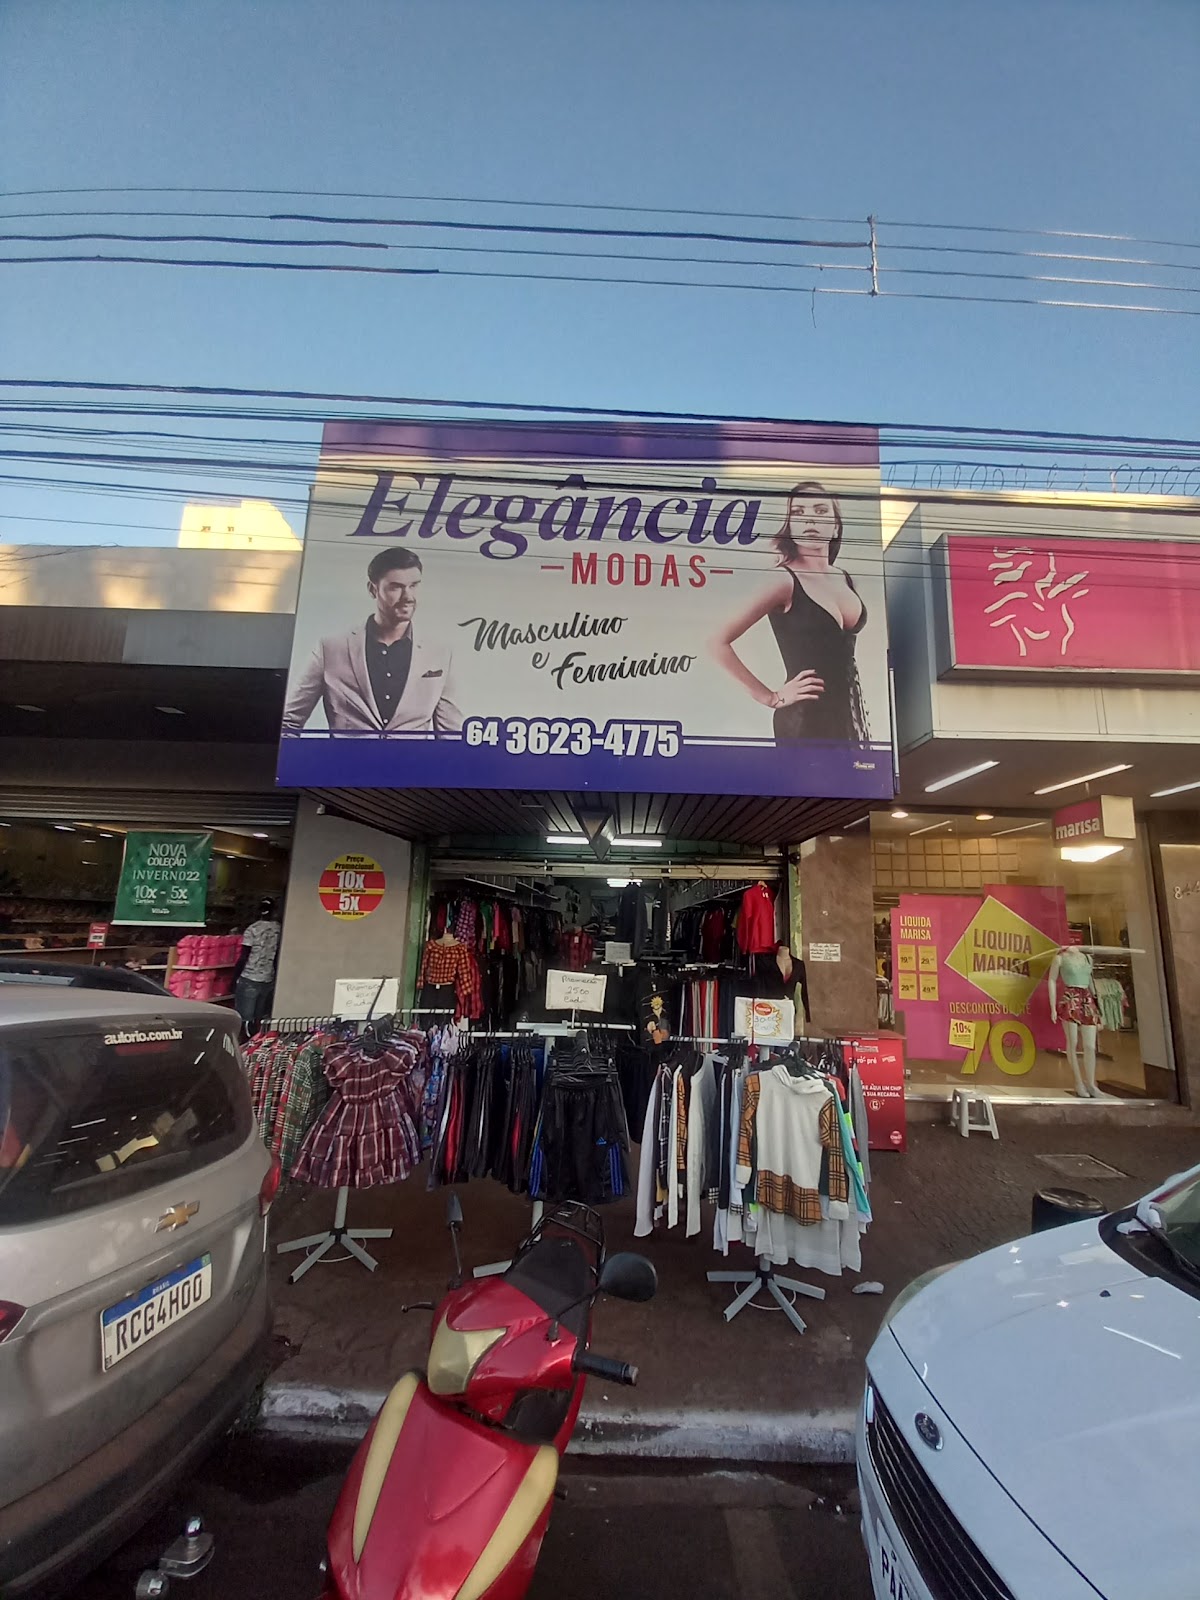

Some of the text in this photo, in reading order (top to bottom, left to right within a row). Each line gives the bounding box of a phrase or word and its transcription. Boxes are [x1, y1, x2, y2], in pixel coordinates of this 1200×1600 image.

[346, 471, 762, 560] Elegância
[571, 552, 707, 588] MODAS
[457, 612, 629, 651] Masculino
[531, 651, 697, 690] e Feminino
[466, 721, 679, 757] 64 3623-4775
[1055, 817, 1101, 840] marisa
[149, 843, 187, 857] NOVA
[346, 855, 365, 863] Preço
[336, 870, 366, 889] 10x
[133, 884, 158, 899] 10x
[170, 885, 188, 899] 5x
[338, 893, 360, 911] 5x
[900, 915, 932, 928] LIQUIDA
[900, 928, 932, 941] MARISA
[973, 928, 1032, 955] LIQUIDA
[972, 952, 1031, 977] MARISA
[949, 1001, 1001, 1015] DESCONTOS
[104, 1028, 183, 1045] autorio.com.br
[116, 1273, 202, 1355] RCG4H00
